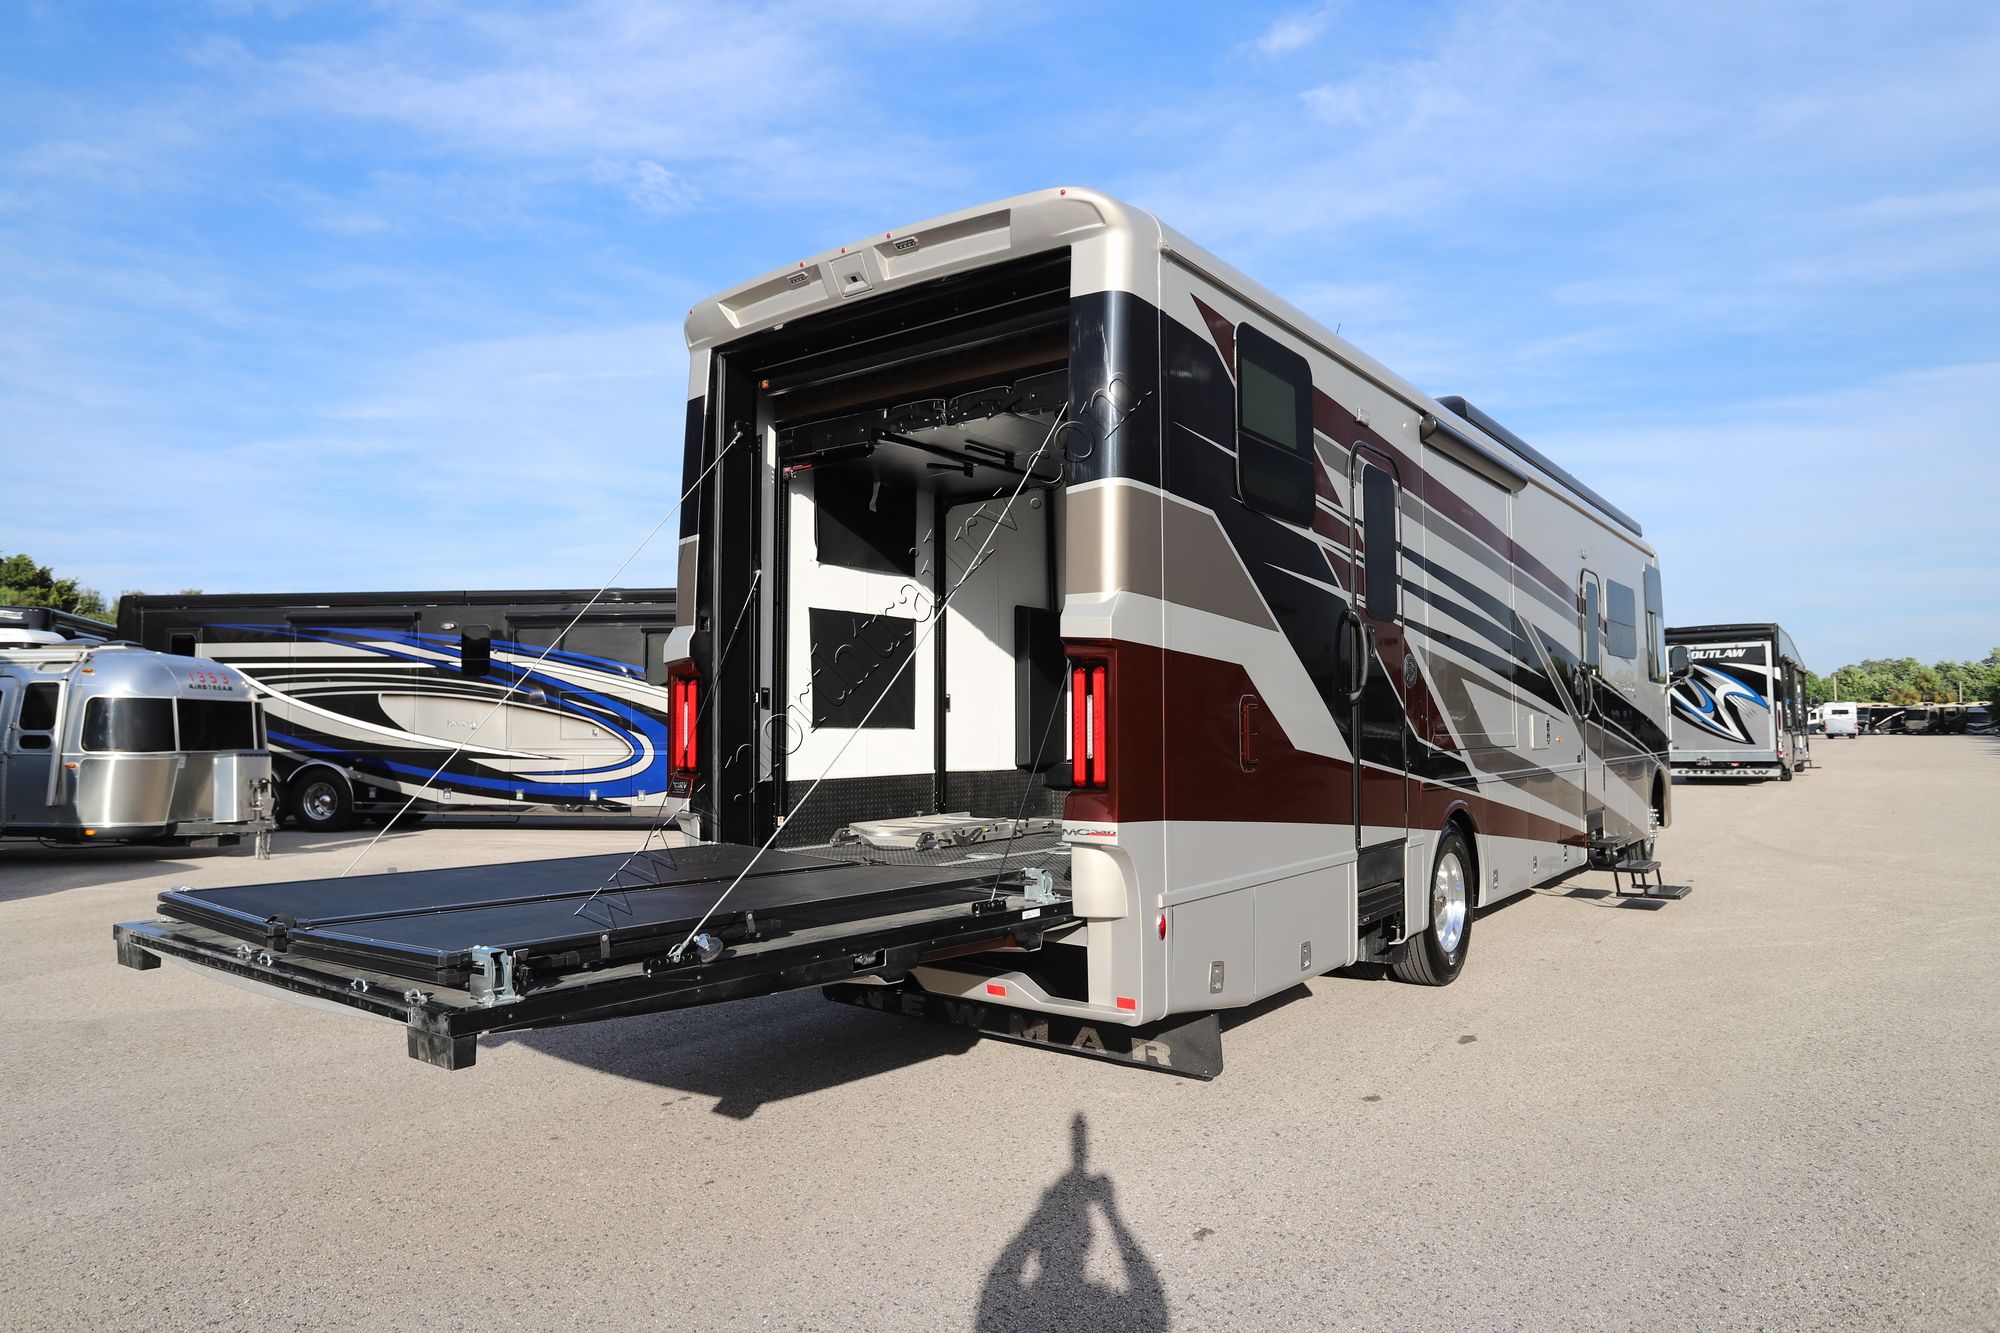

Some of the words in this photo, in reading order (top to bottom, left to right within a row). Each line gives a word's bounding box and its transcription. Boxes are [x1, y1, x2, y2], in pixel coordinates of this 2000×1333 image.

[1691, 648, 1746, 659] OUTLAW
[1677, 768, 1769, 776] OUTLAW
[853, 989, 1172, 1067] NEWMAR
